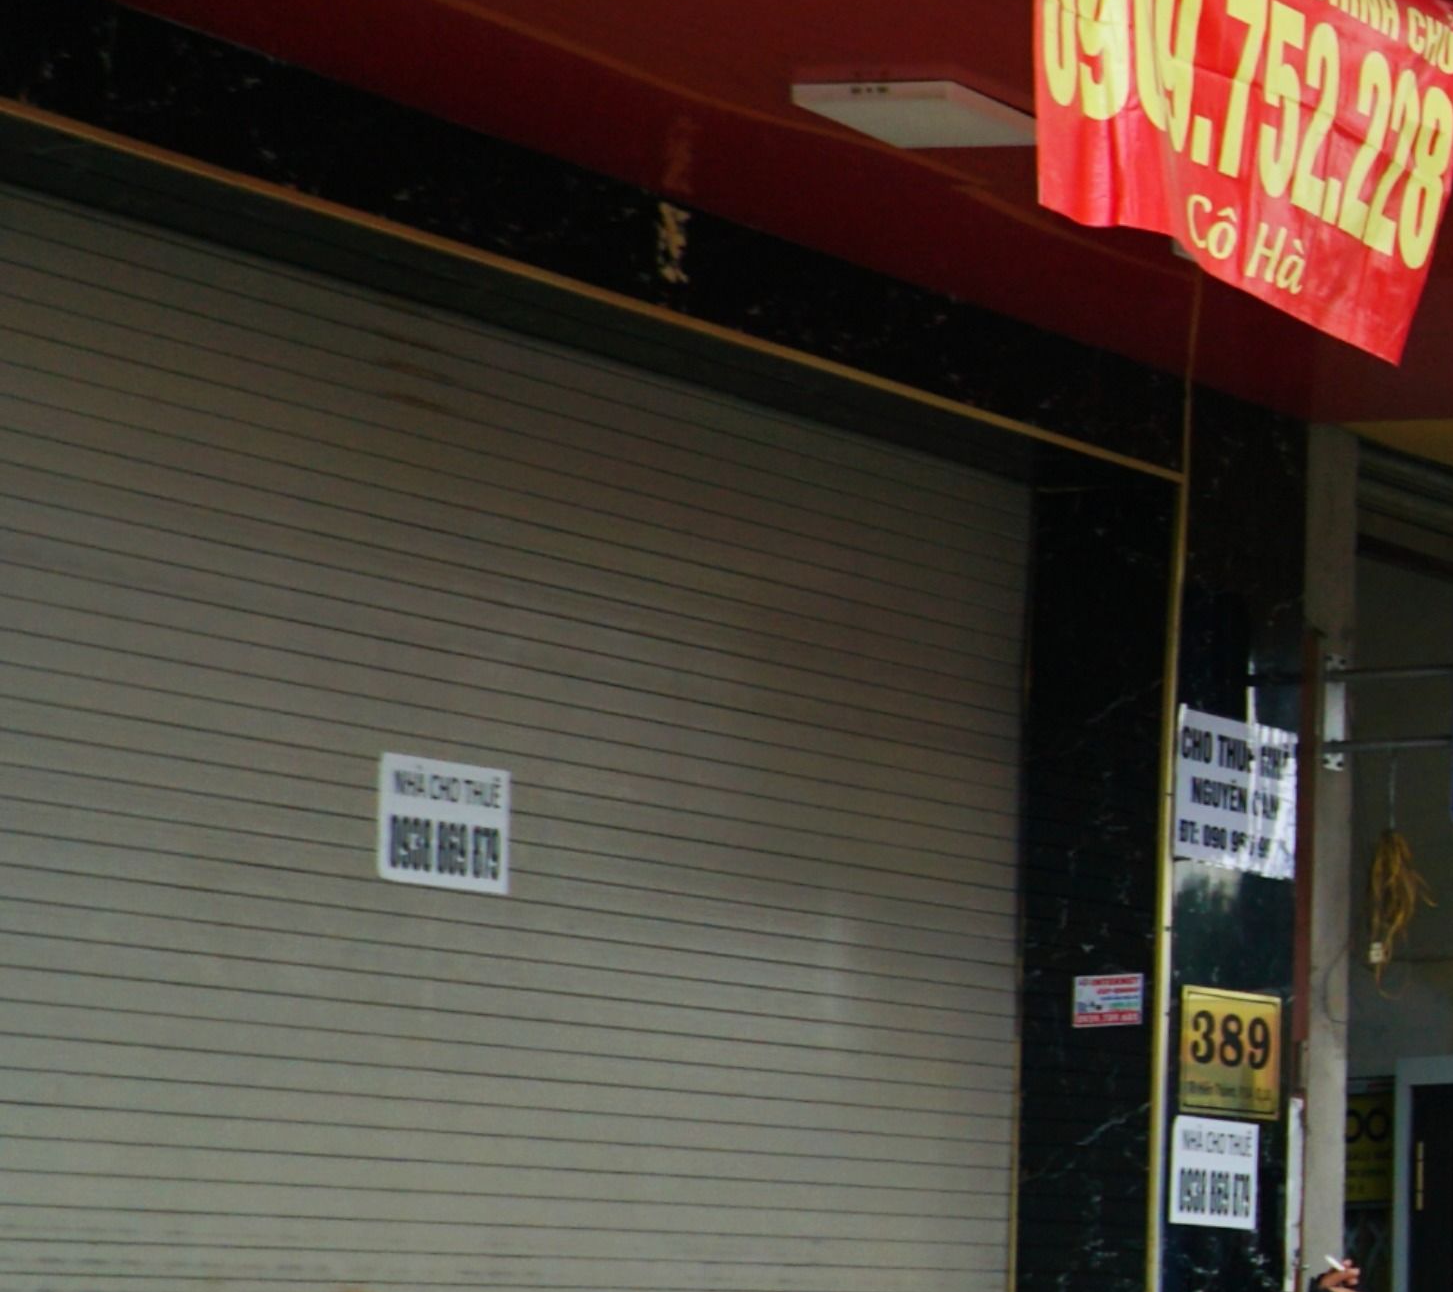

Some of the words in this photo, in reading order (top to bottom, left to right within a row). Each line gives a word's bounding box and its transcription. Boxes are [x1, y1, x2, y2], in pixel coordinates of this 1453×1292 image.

[1185, 194, 1239, 260] Cô
[1244, 220, 1304, 295] Hà
[1190, 1009, 1271, 1070] 389
